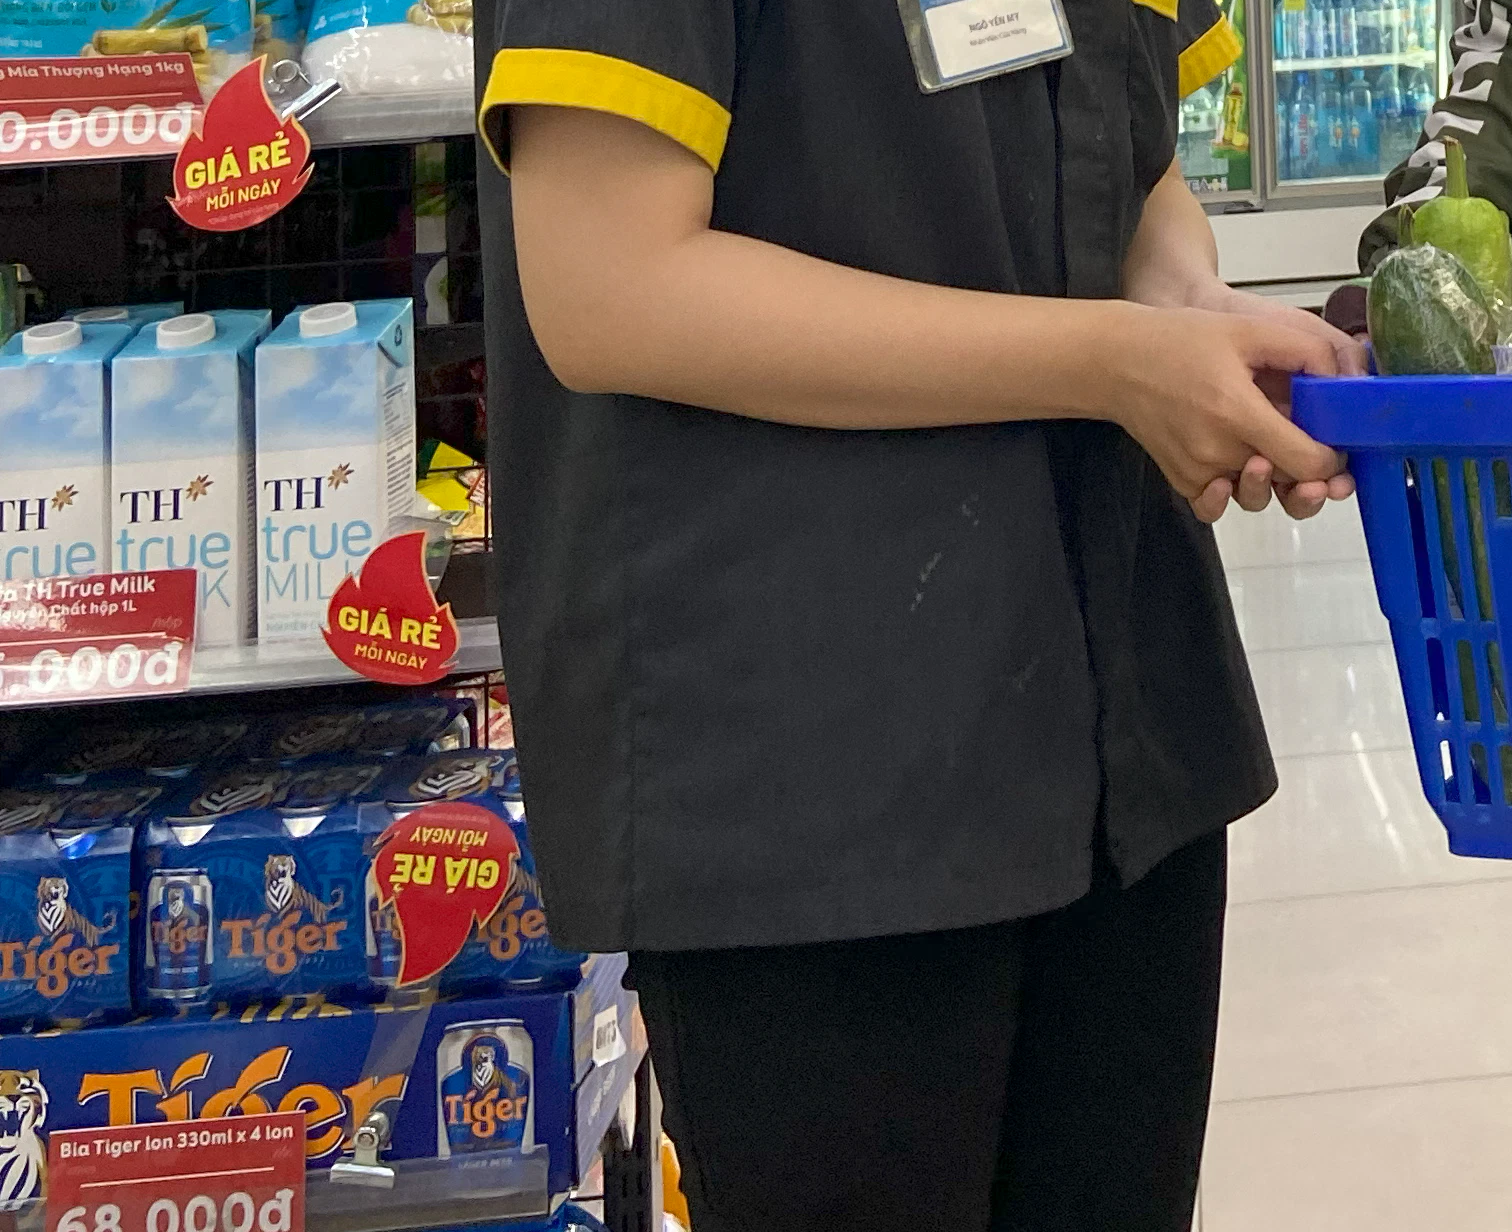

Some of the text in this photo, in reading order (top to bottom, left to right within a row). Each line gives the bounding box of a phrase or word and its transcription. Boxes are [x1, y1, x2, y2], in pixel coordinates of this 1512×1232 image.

[107, 62, 153, 77] Hạng
[155, 60, 184, 76] 1kg
[185, 130, 293, 190] GIÁ RẺ
[205, 178, 282, 212] MỖI NGÀY
[119, 487, 184, 524] TH
[264, 475, 326, 512] TH
[116, 528, 231, 572] true
[262, 516, 373, 563] true
[5, 541, 97, 581] rue
[54, 580, 106, 600] True
[109, 575, 156, 596] Milk
[89, 600, 119, 617] hộp
[121, 599, 138, 613] 1L
[338, 606, 443, 650] GIÁ RẺ
[354, 640, 429, 670] MỖI NGÀY
[410, 825, 489, 853] MỖI NGÀY
[388, 852, 500, 895] GIÁ RẺ
[220, 912, 348, 976] Tiger
[0, 933, 120, 998] Tiger
[444, 1087, 528, 1139] Tiger
[59, 1123, 295, 1159] Bia Tiger lon 330ml x 4 lon
